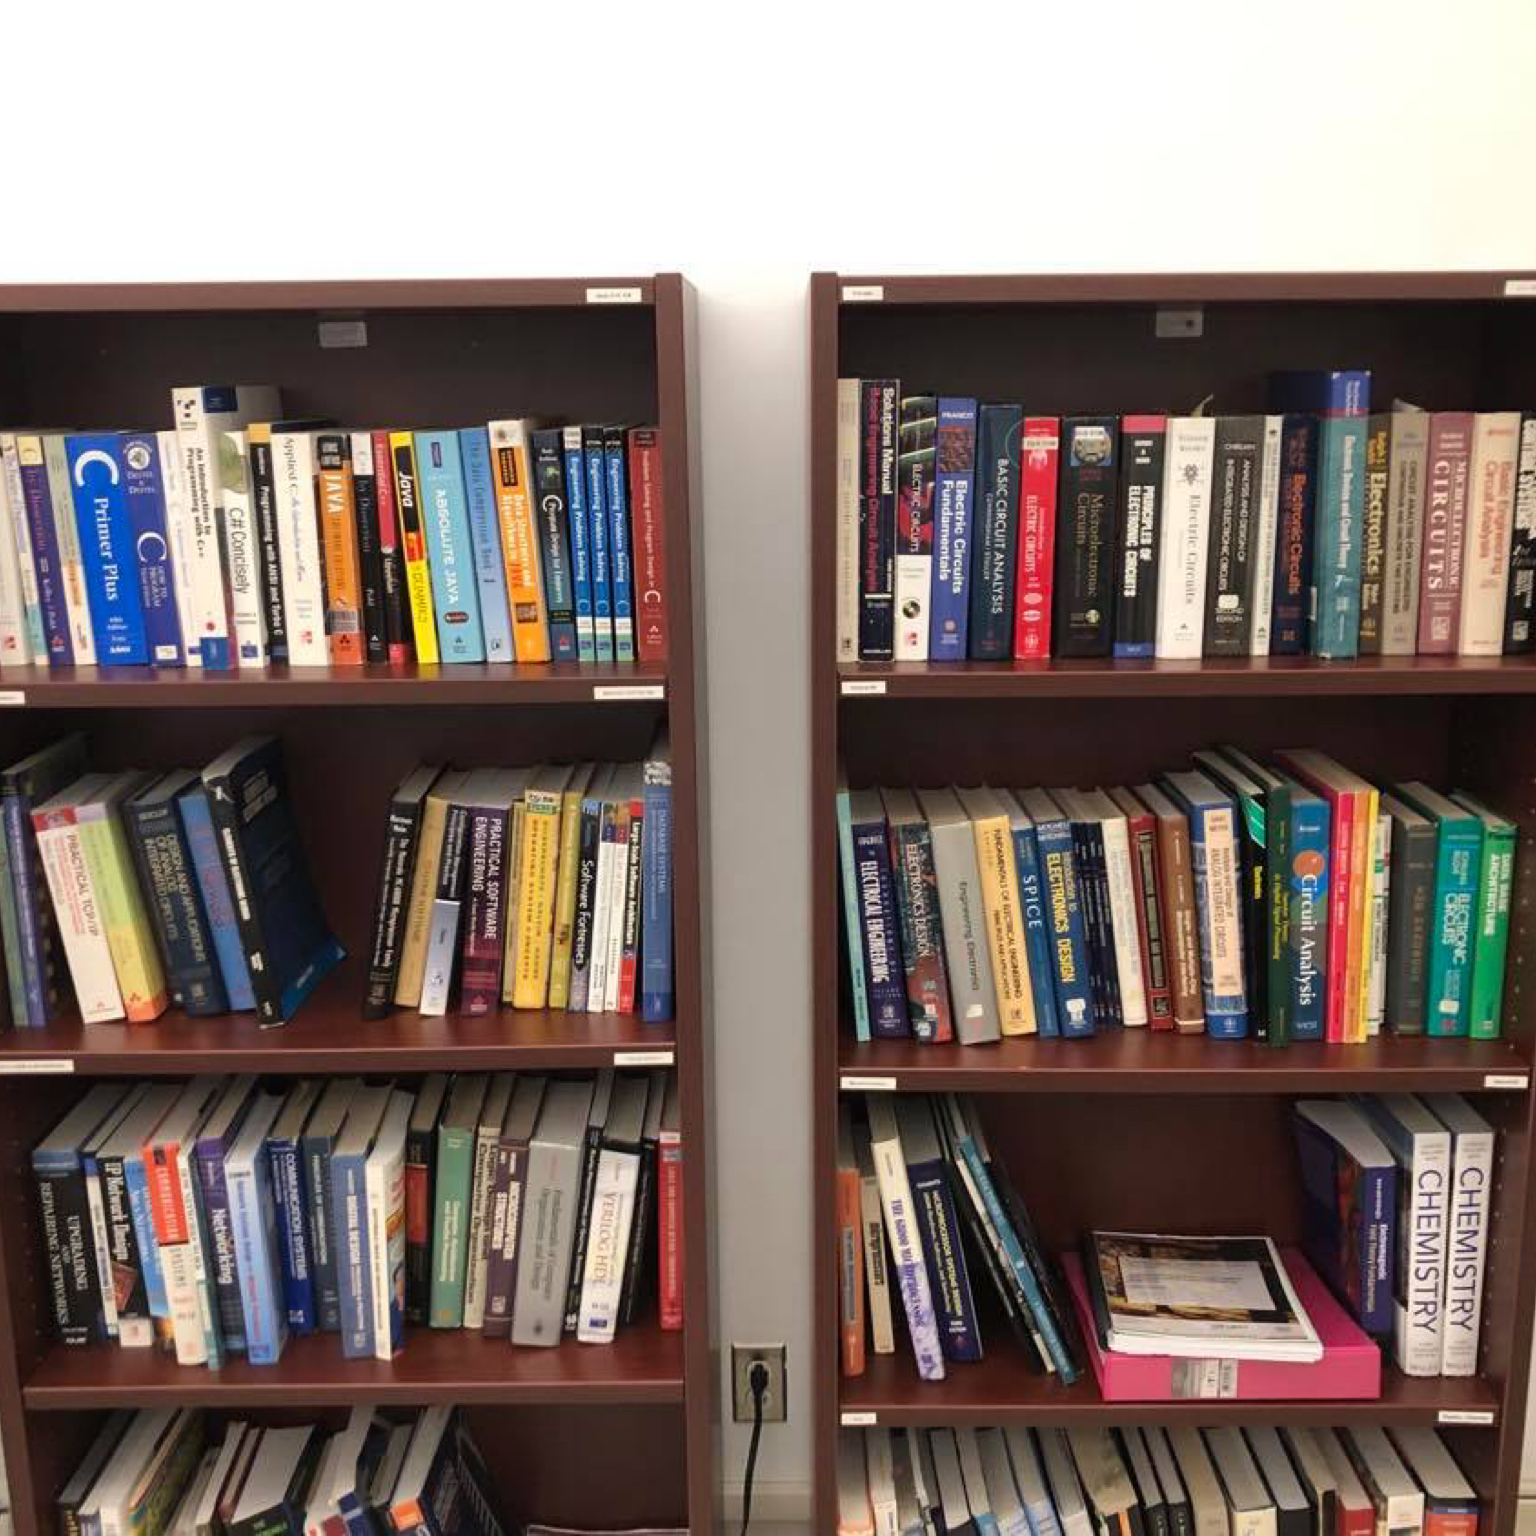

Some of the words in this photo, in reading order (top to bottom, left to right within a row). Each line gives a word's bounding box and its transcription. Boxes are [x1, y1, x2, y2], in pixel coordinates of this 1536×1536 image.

[881, 388, 895, 446] Solutions
[74, 450, 119, 487] C
[187, 447, 200, 514] Programming
[199, 463, 211, 523] Introduction
[325, 474, 345, 514] JAVA
[399, 471, 414, 508] Java
[610, 458, 621, 511] Engineering
[881, 449, 893, 495] Manual
[911, 463, 923, 507] ELECTRIC
[996, 458, 1010, 497] BASIC
[94, 498, 113, 560] Primer
[229, 508, 245, 530] C#
[614, 512, 624, 550] Problem
[909, 511, 921, 552] CIRCUITS
[939, 480, 955, 582] Fundamentals
[954, 480, 969, 534] Electric
[993, 500, 1008, 549] CIRCUIT
[1076, 493, 1090, 545] Circuits
[1126, 485, 1141, 547] ELECTRONIC
[1140, 485, 1156, 545] PRINCIPLES
[1187, 494, 1202, 549] Electric
[1367, 473, 1388, 576] Electronics
[1427, 460, 1451, 589] CIRCUITS
[1449, 461, 1467, 587] MICROELECTRONIC
[137, 531, 167, 562] C
[231, 532, 251, 594] Concisely
[434, 490, 455, 565] ABSOLUTE
[446, 569, 459, 604] JAVA
[615, 551, 625, 582] Solving
[951, 538, 968, 594] Circuits
[1087, 494, 1106, 597] Microelectronic
[1140, 548, 1153, 562] OF
[103, 564, 119, 601] Plus
[991, 552, 1006, 614] ANALYSIS
[1124, 551, 1138, 598] CIRCUITS
[1185, 553, 1198, 605] Circuits
[67, 834, 88, 895] PRACTICAL
[471, 816, 488, 892] ENGINEERING
[487, 818, 502, 877] PRACTICAL
[578, 859, 595, 908] Software
[861, 861, 884, 917] ELECTRICAL
[905, 844, 927, 917] ELECTRONICS
[1022, 874, 1043, 930] SPICE
[1046, 853, 1070, 934] ELECTRONICS
[1300, 873, 1318, 932] Circuit
[484, 880, 500, 940] SOFTWARE
[574, 910, 590, 967] Fortresses
[914, 919, 931, 958] DESIGN
[957, 881, 975, 941] Engineering
[1441, 893, 1458, 945] CIRCUITS
[1451, 893, 1472, 965] ELECTRONIC
[867, 919, 891, 984] ENGINEERING
[1056, 938, 1076, 983] DESIGN
[1293, 936, 1318, 1006] Analysis
[104, 1162, 122, 1175] IP
[286, 1153, 304, 1234] COMMUNICATION
[41, 1182, 60, 1251] REPAIRING
[106, 1177, 126, 1221] Network
[67, 1215, 89, 1291] UPGRADING
[111, 1223, 131, 1261] Design
[211, 1208, 235, 1284] Networking
[292, 1236, 308, 1281] SYSTEMS
[1413, 1169, 1443, 1333] CHEMISTRY
[1450, 1167, 1485, 1331] CHEMISTRY
[50, 1253, 70, 1325] NETWORKS
